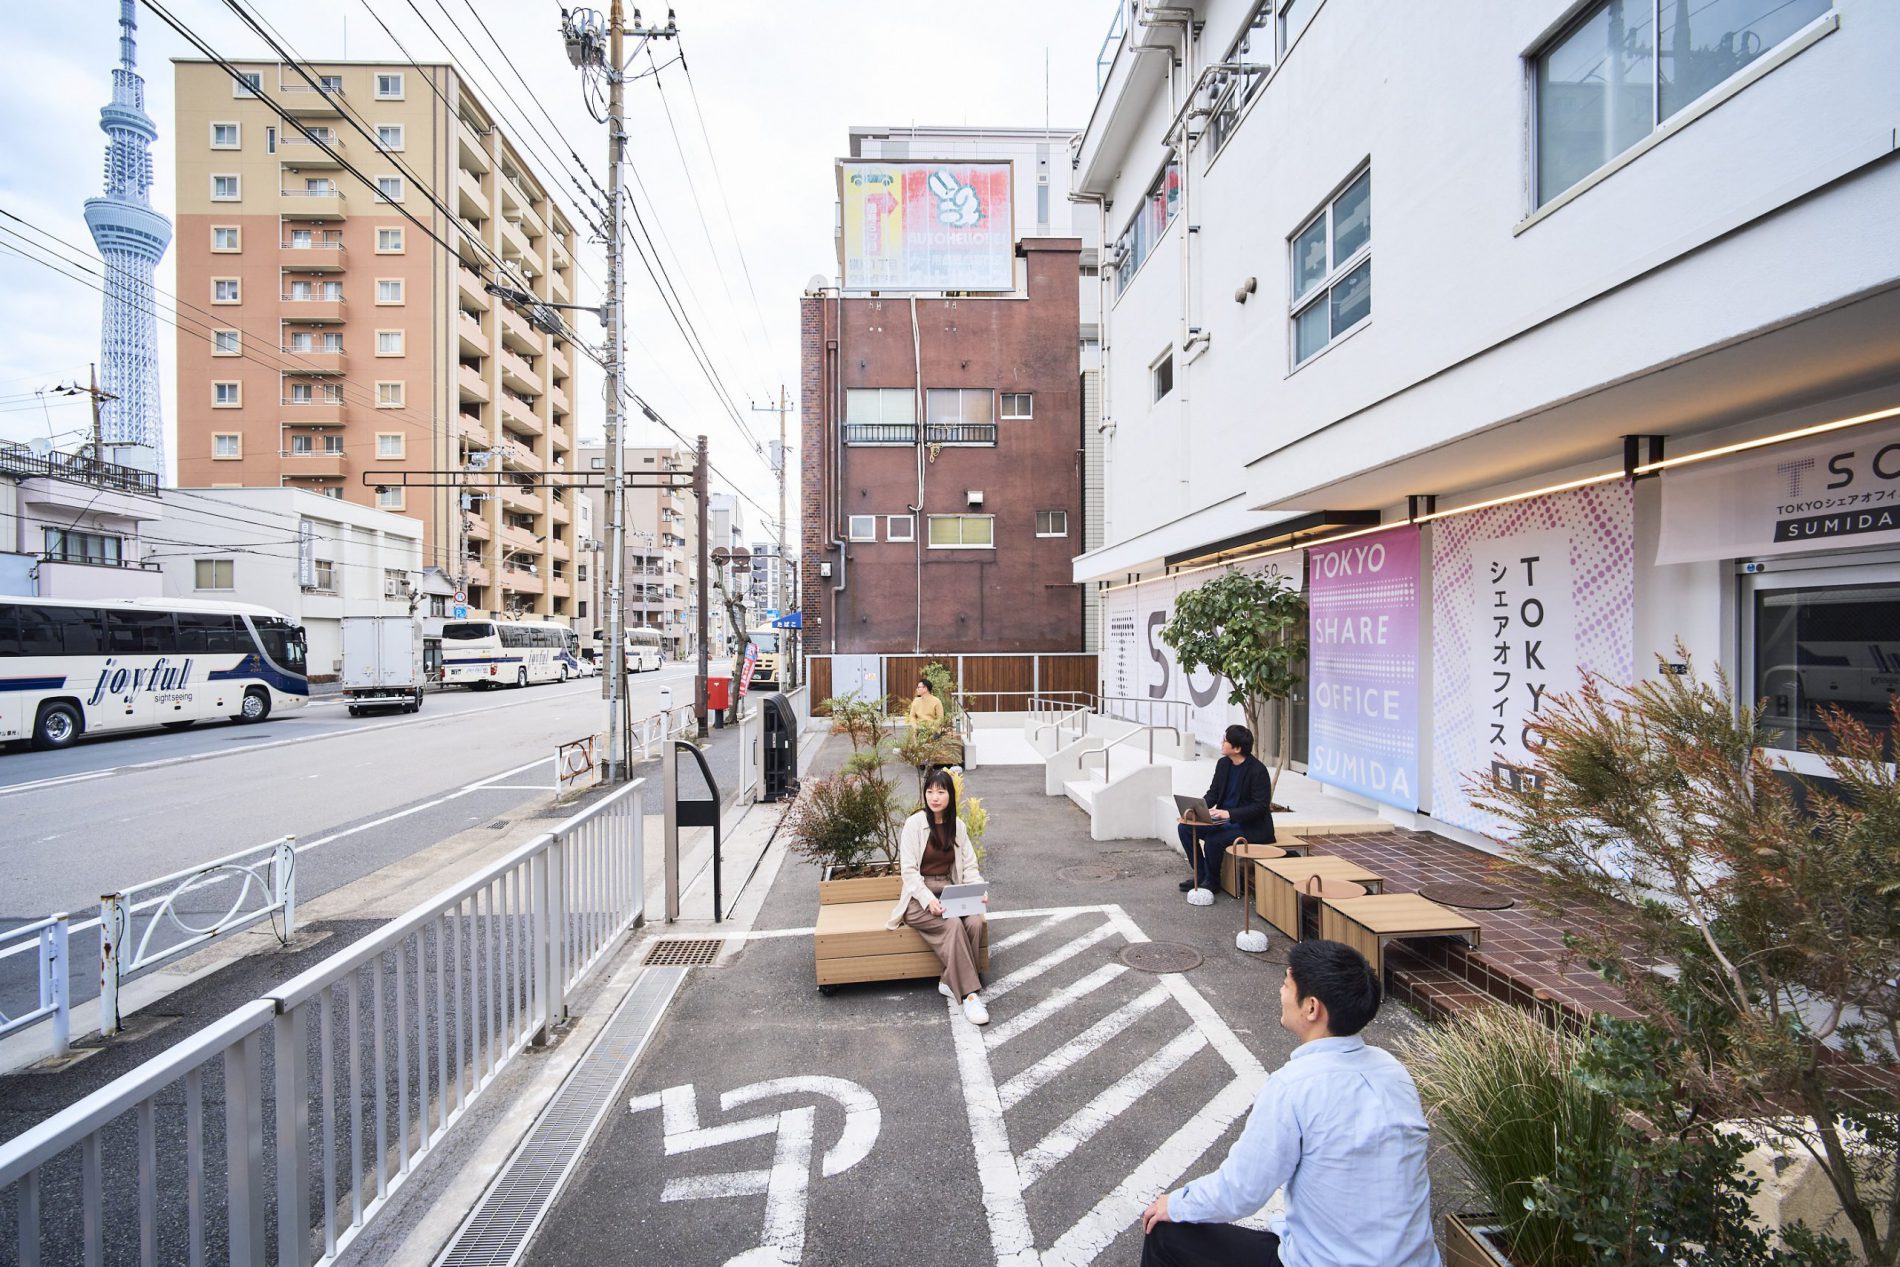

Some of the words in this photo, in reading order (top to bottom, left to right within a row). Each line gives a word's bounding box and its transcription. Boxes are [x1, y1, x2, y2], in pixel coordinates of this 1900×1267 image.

[1776, 489, 1900, 515] TOKYOシェアオフィ
[1788, 511, 1893, 537] SUMIDA
[1313, 542, 1386, 580] TOKYO
[1316, 615, 1389, 645] SHARE
[1490, 561, 1511, 746] シェアオフィス
[87, 657, 193, 706] joyful
[154, 692, 193, 704] sightseeing
[1316, 681, 1400, 721] OFFICE
[1313, 745, 1410, 799] SUMIDA
